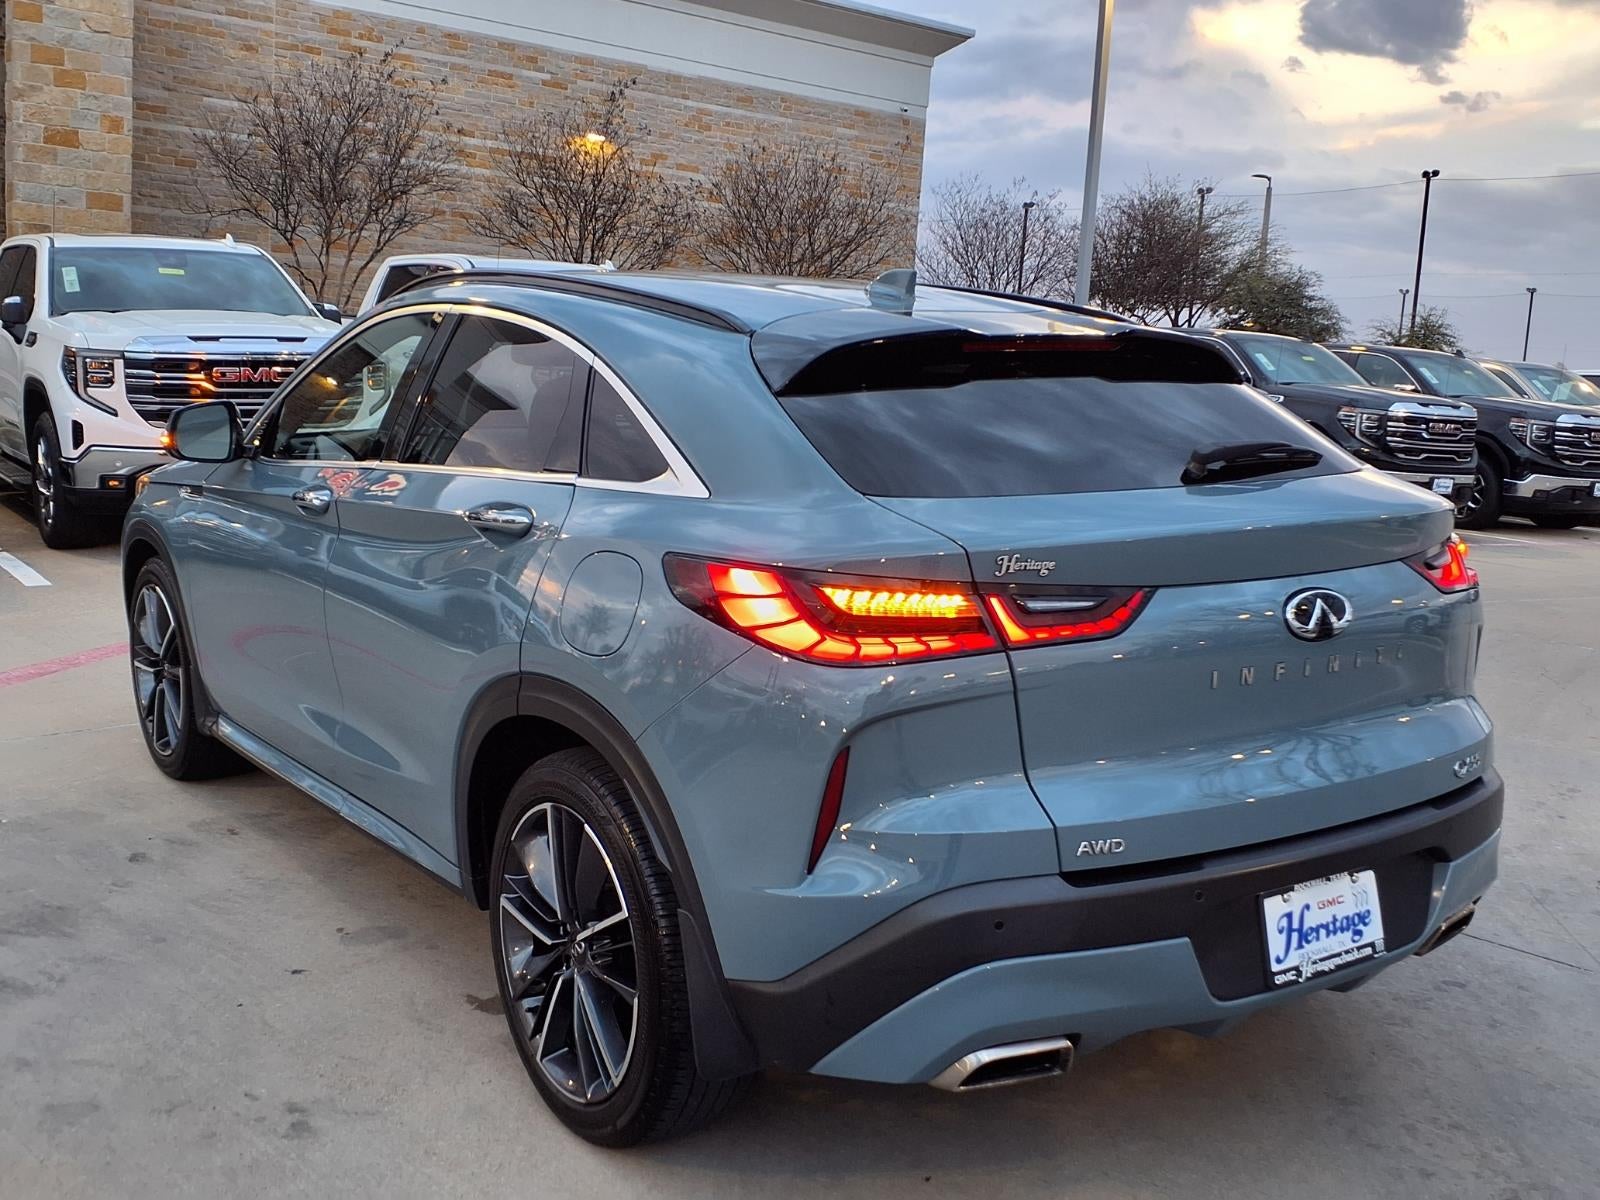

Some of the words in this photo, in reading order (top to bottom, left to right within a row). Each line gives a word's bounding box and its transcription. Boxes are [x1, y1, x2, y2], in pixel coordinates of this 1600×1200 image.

[212, 366, 296, 382] GMC
[994, 553, 1056, 577] Heritage
[1211, 643, 1402, 689] INFINITI
[1076, 838, 1126, 857] AWD
[1316, 895, 1345, 910] GMC
[1275, 902, 1373, 966] Heritage
[1274, 970, 1298, 985] GMC
